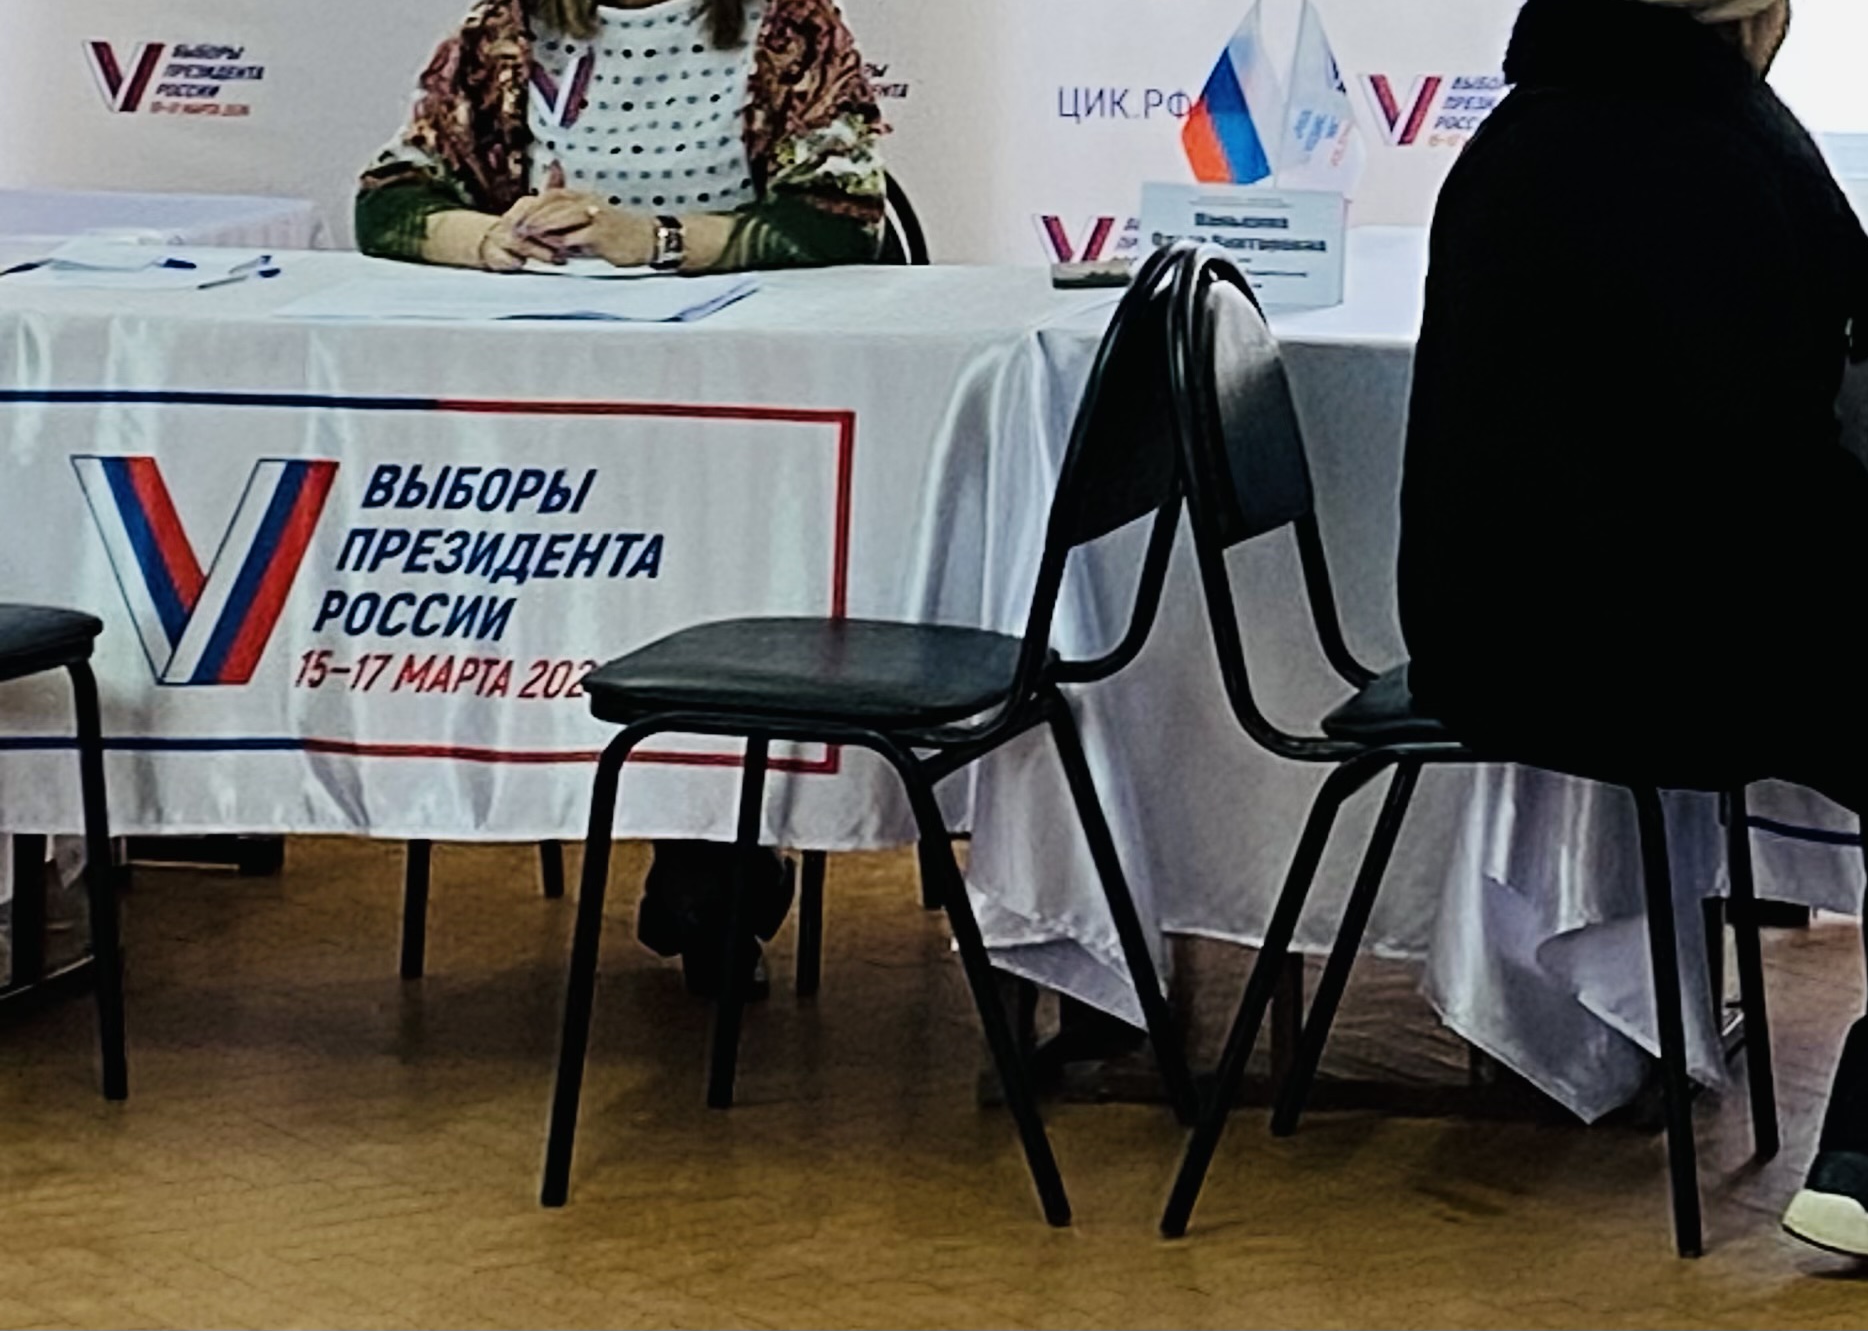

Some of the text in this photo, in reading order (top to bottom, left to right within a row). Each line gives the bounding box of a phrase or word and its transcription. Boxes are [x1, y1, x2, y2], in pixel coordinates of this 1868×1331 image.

[1058, 86, 1191, 124] ЦИК.РФ
[360, 464, 598, 515] ВЫБОРЫ
[335, 528, 667, 585] ПРЕЗИДЕНТА
[312, 590, 517, 643] РОССИИ
[392, 654, 515, 699] МАРТА
[517, 658, 598, 699] 202
